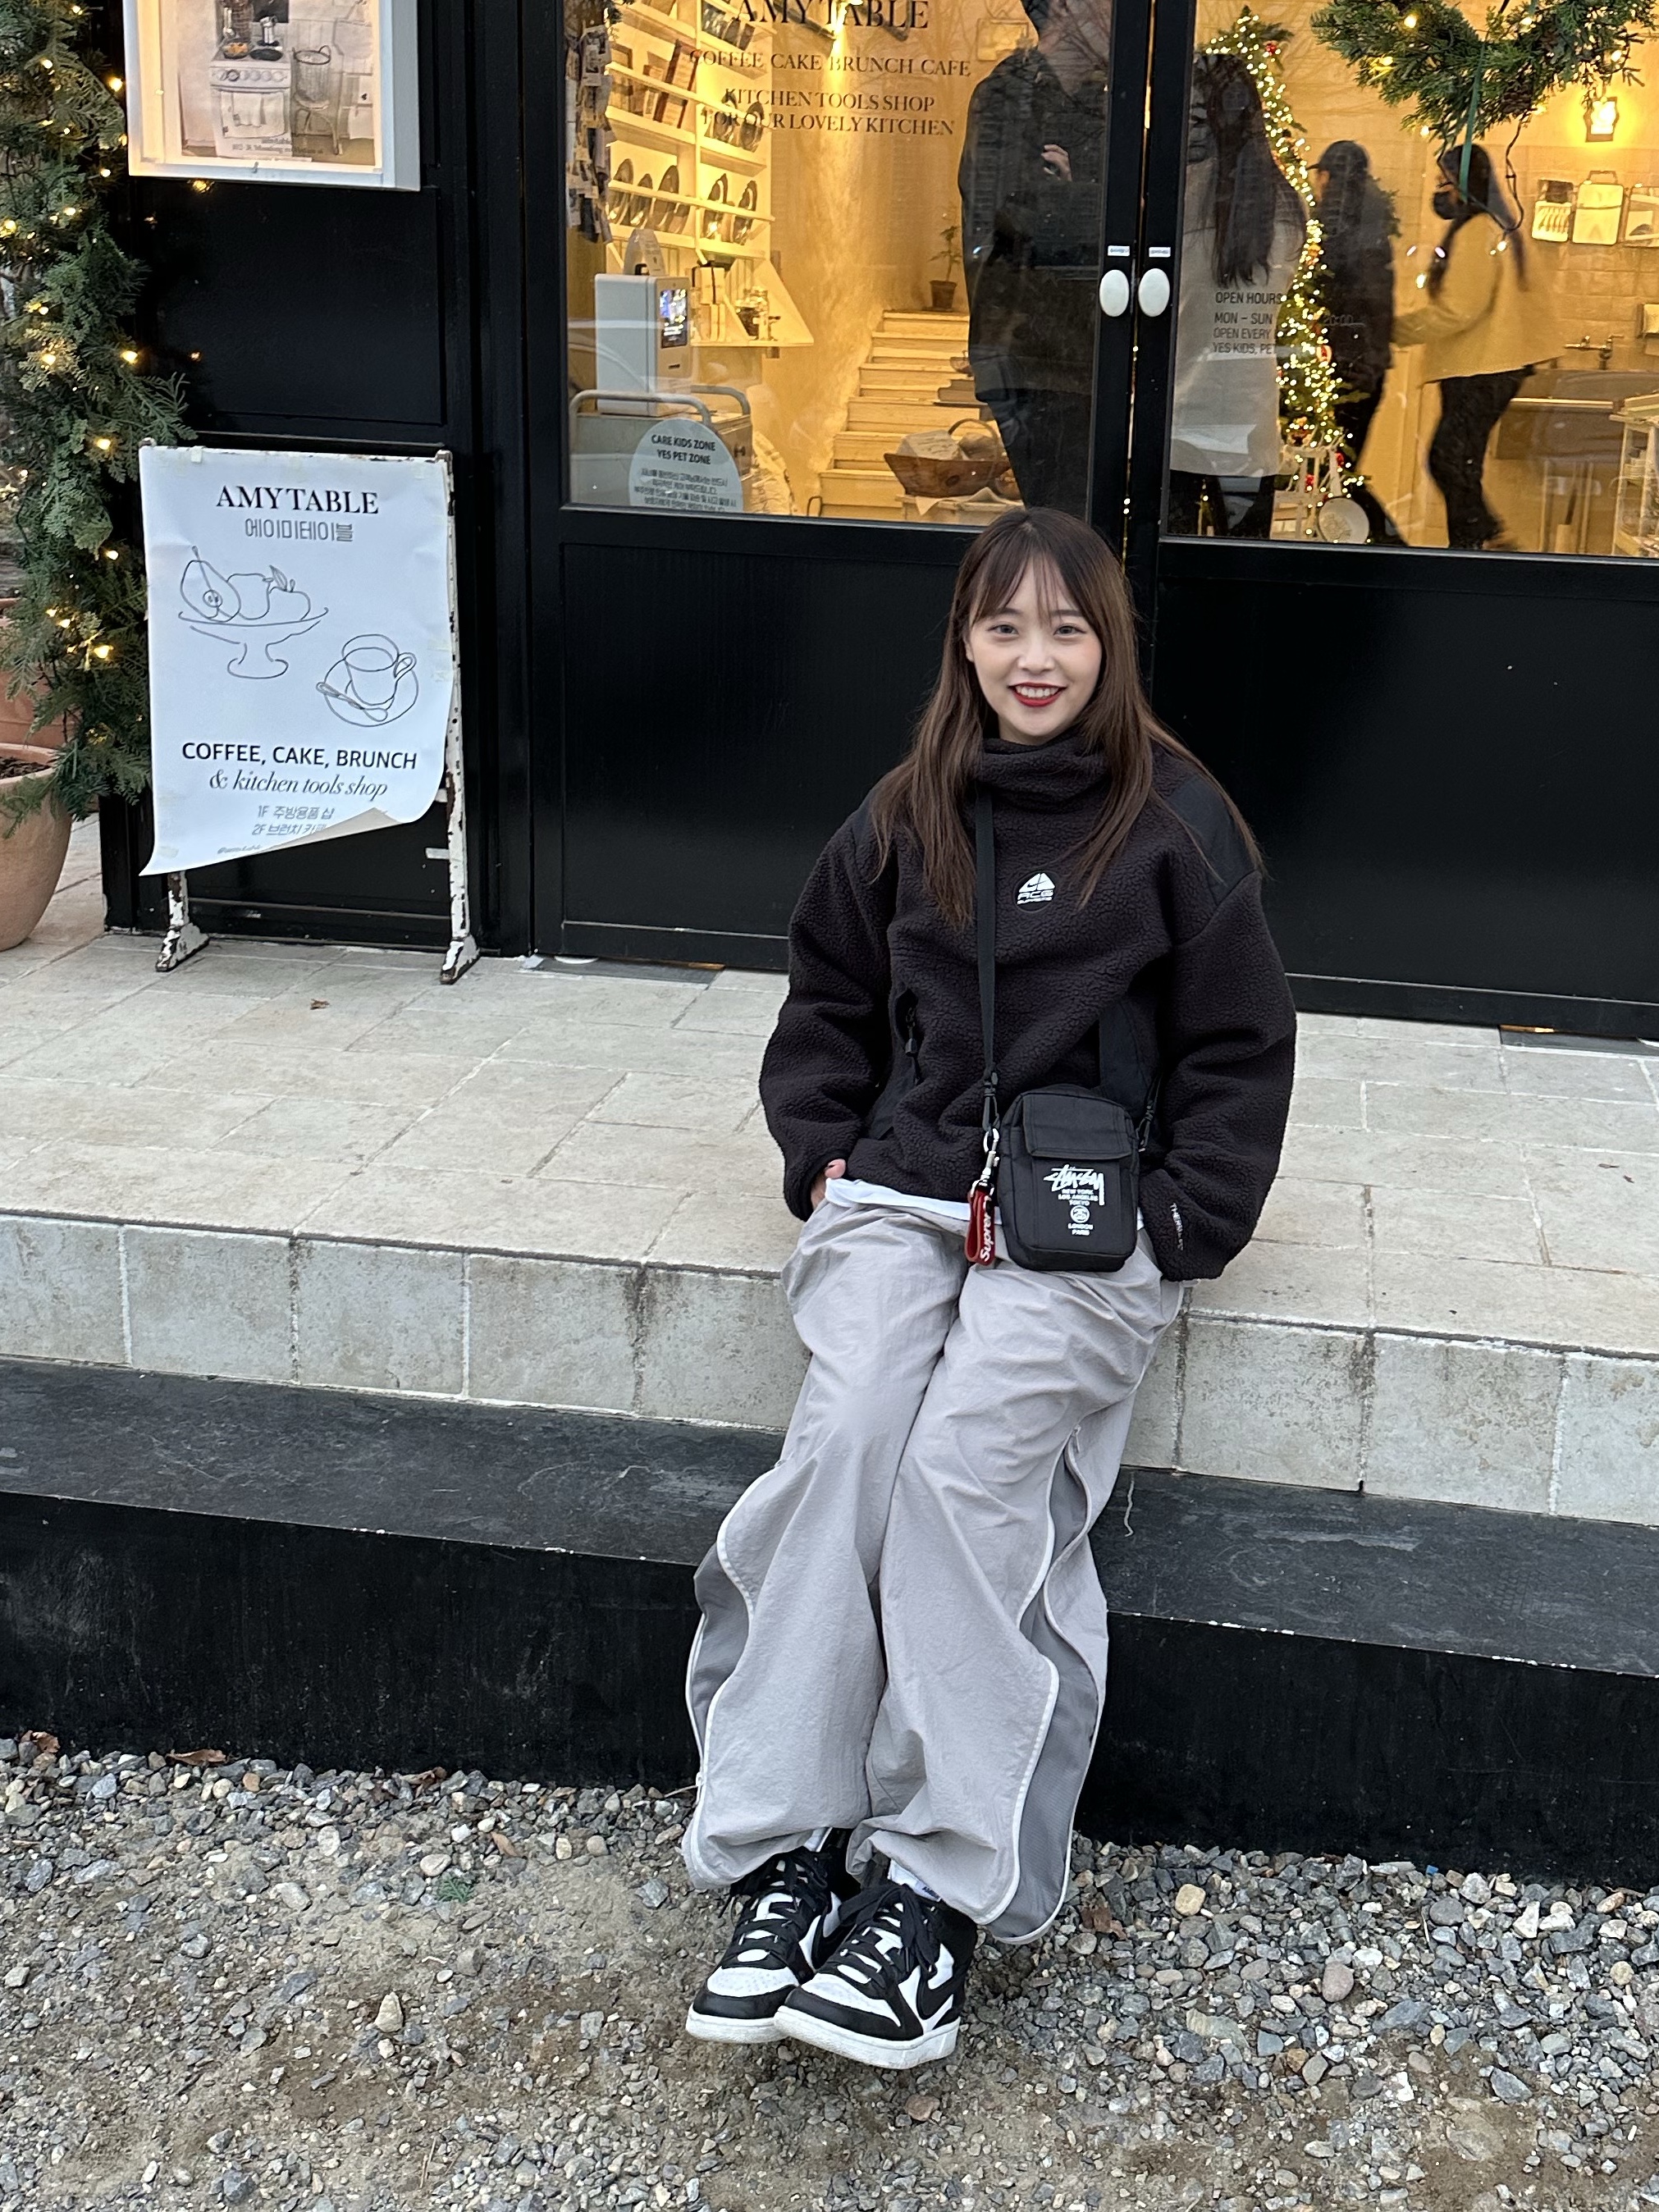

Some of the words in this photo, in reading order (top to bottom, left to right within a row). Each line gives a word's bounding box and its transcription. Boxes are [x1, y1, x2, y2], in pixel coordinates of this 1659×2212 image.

[735, 0, 812, 24] AMY
[823, 0, 929, 29] TABLE
[690, 49, 765, 68] COFFEE
[770, 53, 822, 71] CAKE
[830, 56, 913, 75] BRUNCH
[921, 59, 971, 77] CAFE
[725, 88, 812, 107] KITCHEN
[814, 92, 880, 110] TOOLS
[882, 95, 935, 112] SHOP
[701, 107, 741, 126] FOR
[743, 112, 786, 130] OUR
[789, 113, 863, 132] LOVELY
[866, 117, 955, 135] KITCHEN
[1215, 291, 1245, 304] OPEN
[1246, 292, 1283, 305] HOURS
[1214, 313, 1239, 324] MON
[1250, 313, 1273, 325] SUN
[1213, 328, 1240, 340] OPEN
[1241, 328, 1271, 340] EVERY
[1213, 342, 1234, 353] YES
[1234, 343, 1258, 355] KIDS,
[651, 435, 672, 446] CARE
[674, 436, 692, 449] KIDS
[693, 440, 715, 451] ZONE
[657, 449, 671, 459] YES
[673, 451, 688, 462] PET
[689, 454, 711, 465] ZONE
[216, 485, 284, 510] AMY
[285, 487, 379, 514] TABLE
[245, 518, 354, 542] 에이미테이블
[182, 742, 267, 766] COFFEE,
[272, 746, 329, 769] CAKE,
[336, 749, 417, 770] BRUNCH
[209, 769, 228, 789] &
[232, 769, 299, 793] kitchen
[302, 774, 344, 795] tools
[345, 775, 388, 802] shop
[1017, 889, 1054, 900] ACG
[980, 1195, 994, 1262] Supre
